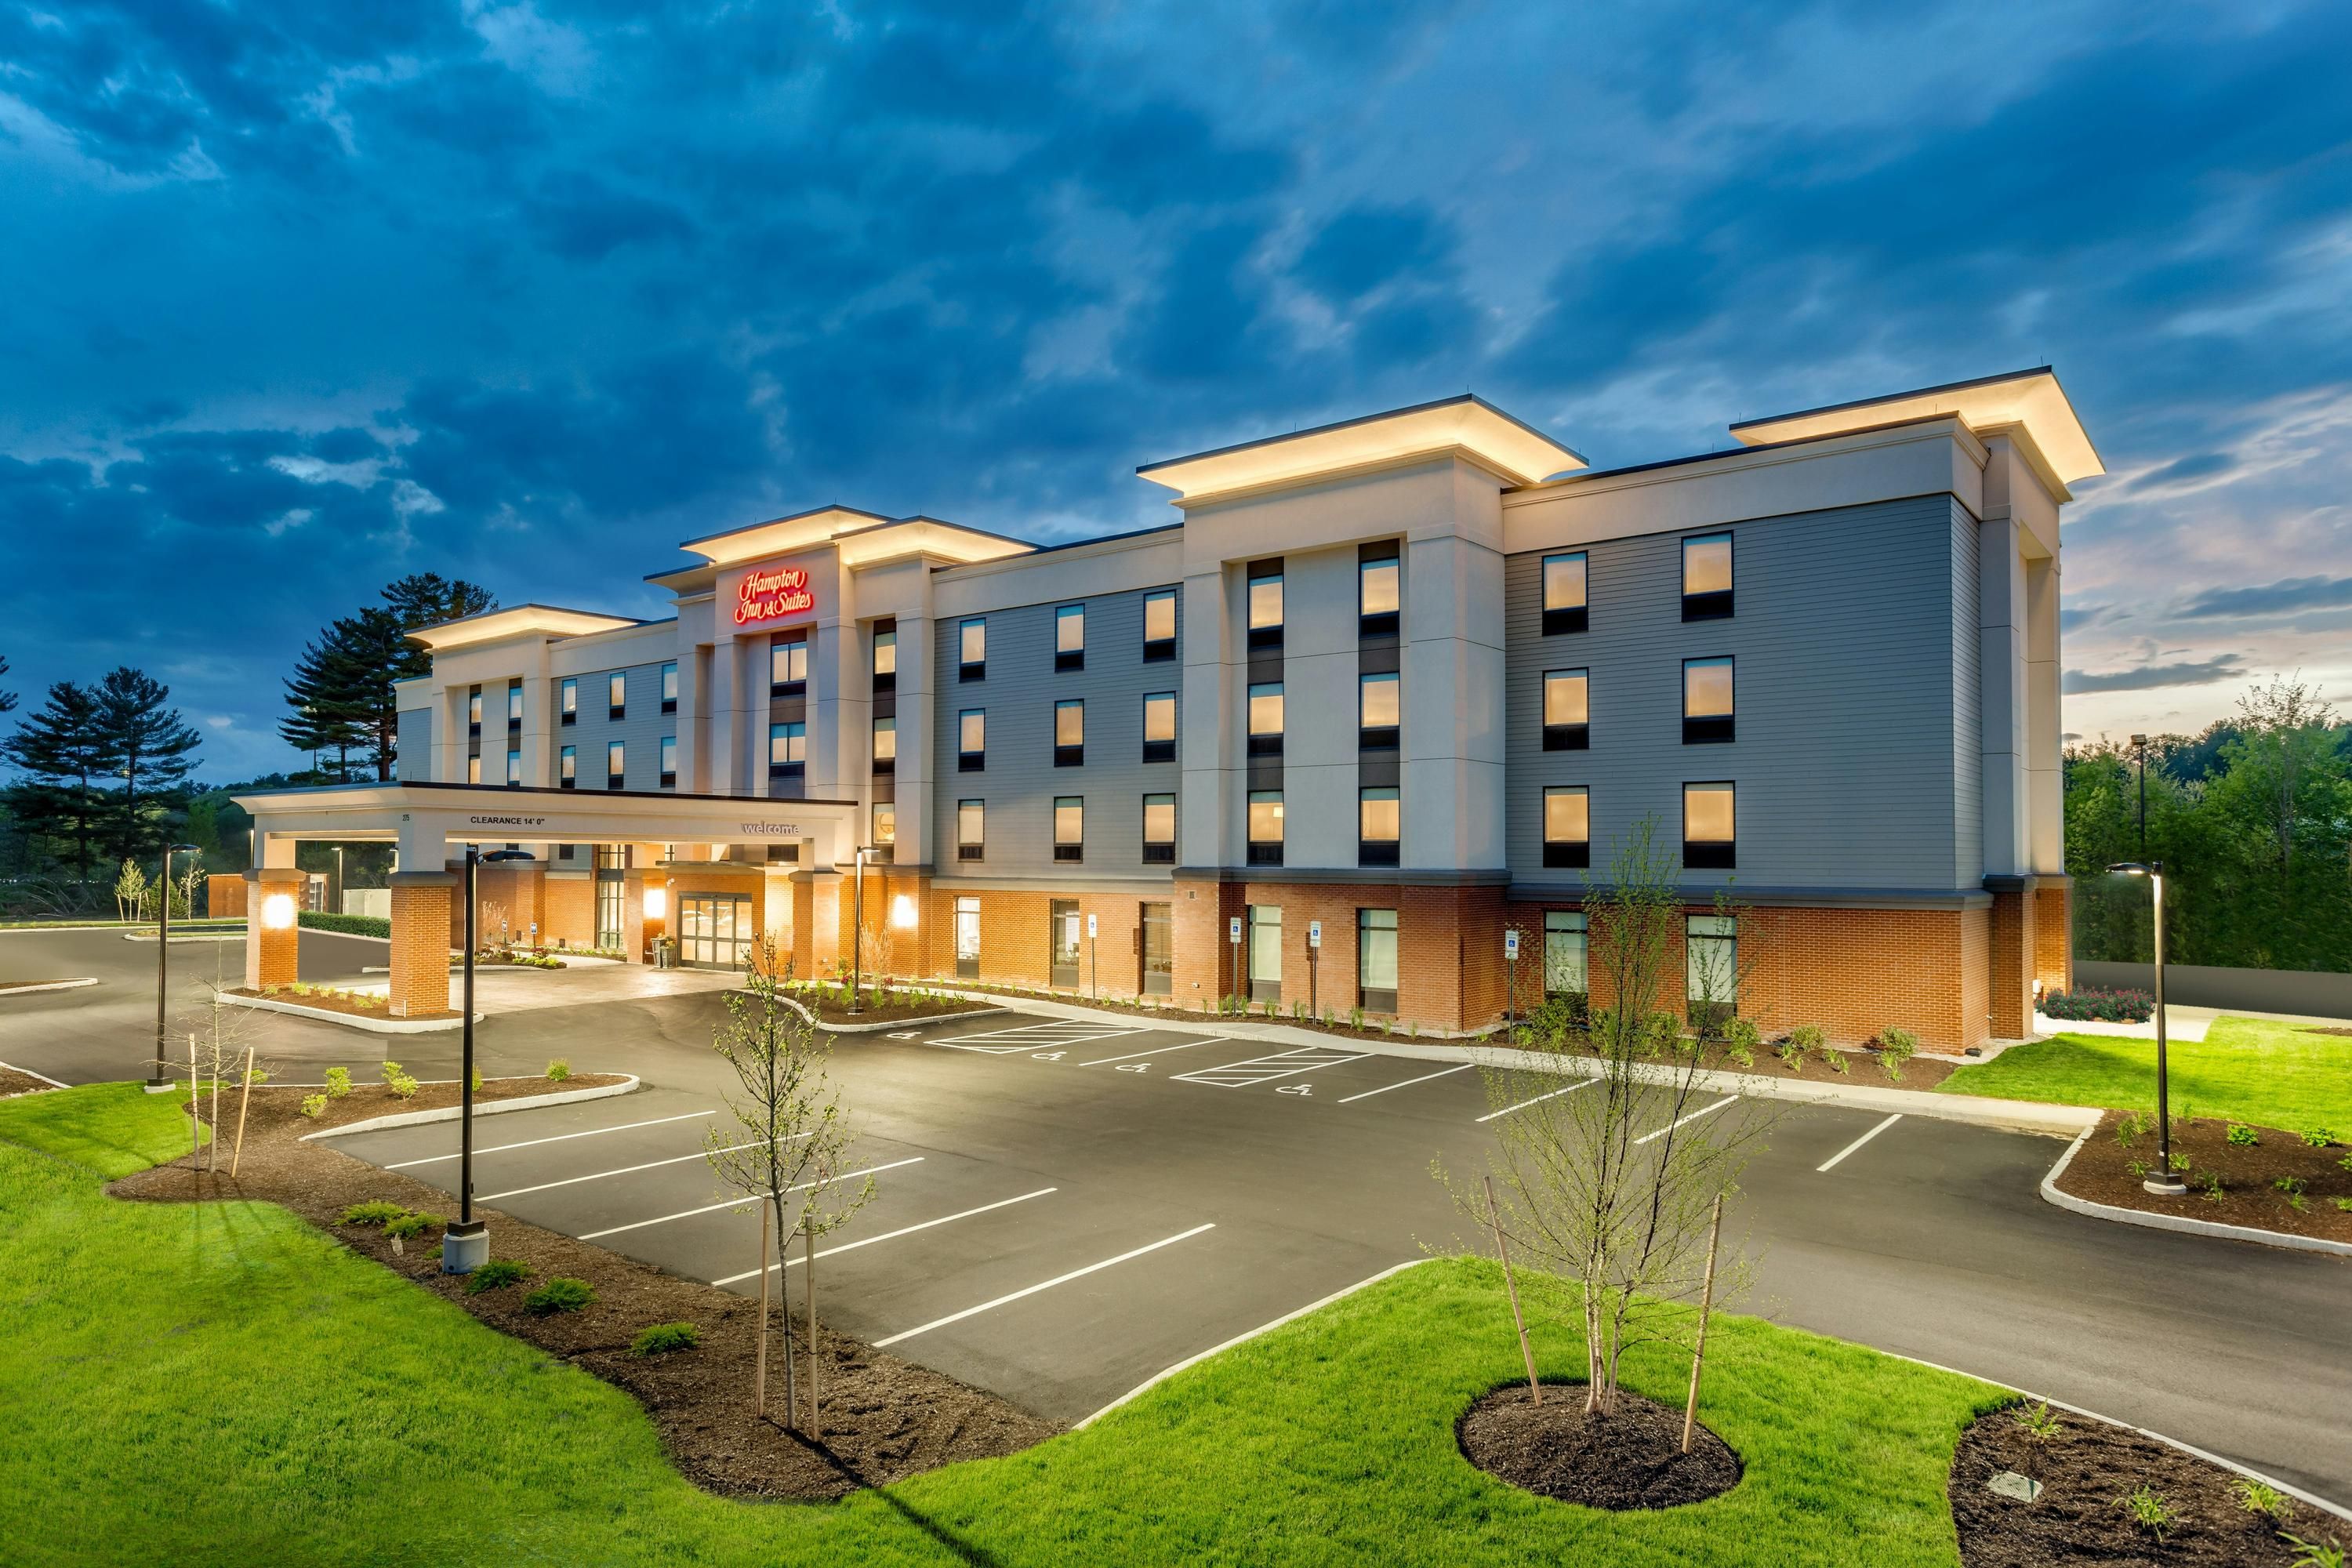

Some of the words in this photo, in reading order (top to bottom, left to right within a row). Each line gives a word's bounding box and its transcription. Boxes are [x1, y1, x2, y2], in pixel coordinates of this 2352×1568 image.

[739, 569, 807, 602] Hampton
[735, 599, 768, 623] Inn
[766, 601, 776, 617] &
[774, 590, 811, 615] Suites
[470, 816, 522, 825] CLEARANCE
[742, 821, 800, 834] welcome
